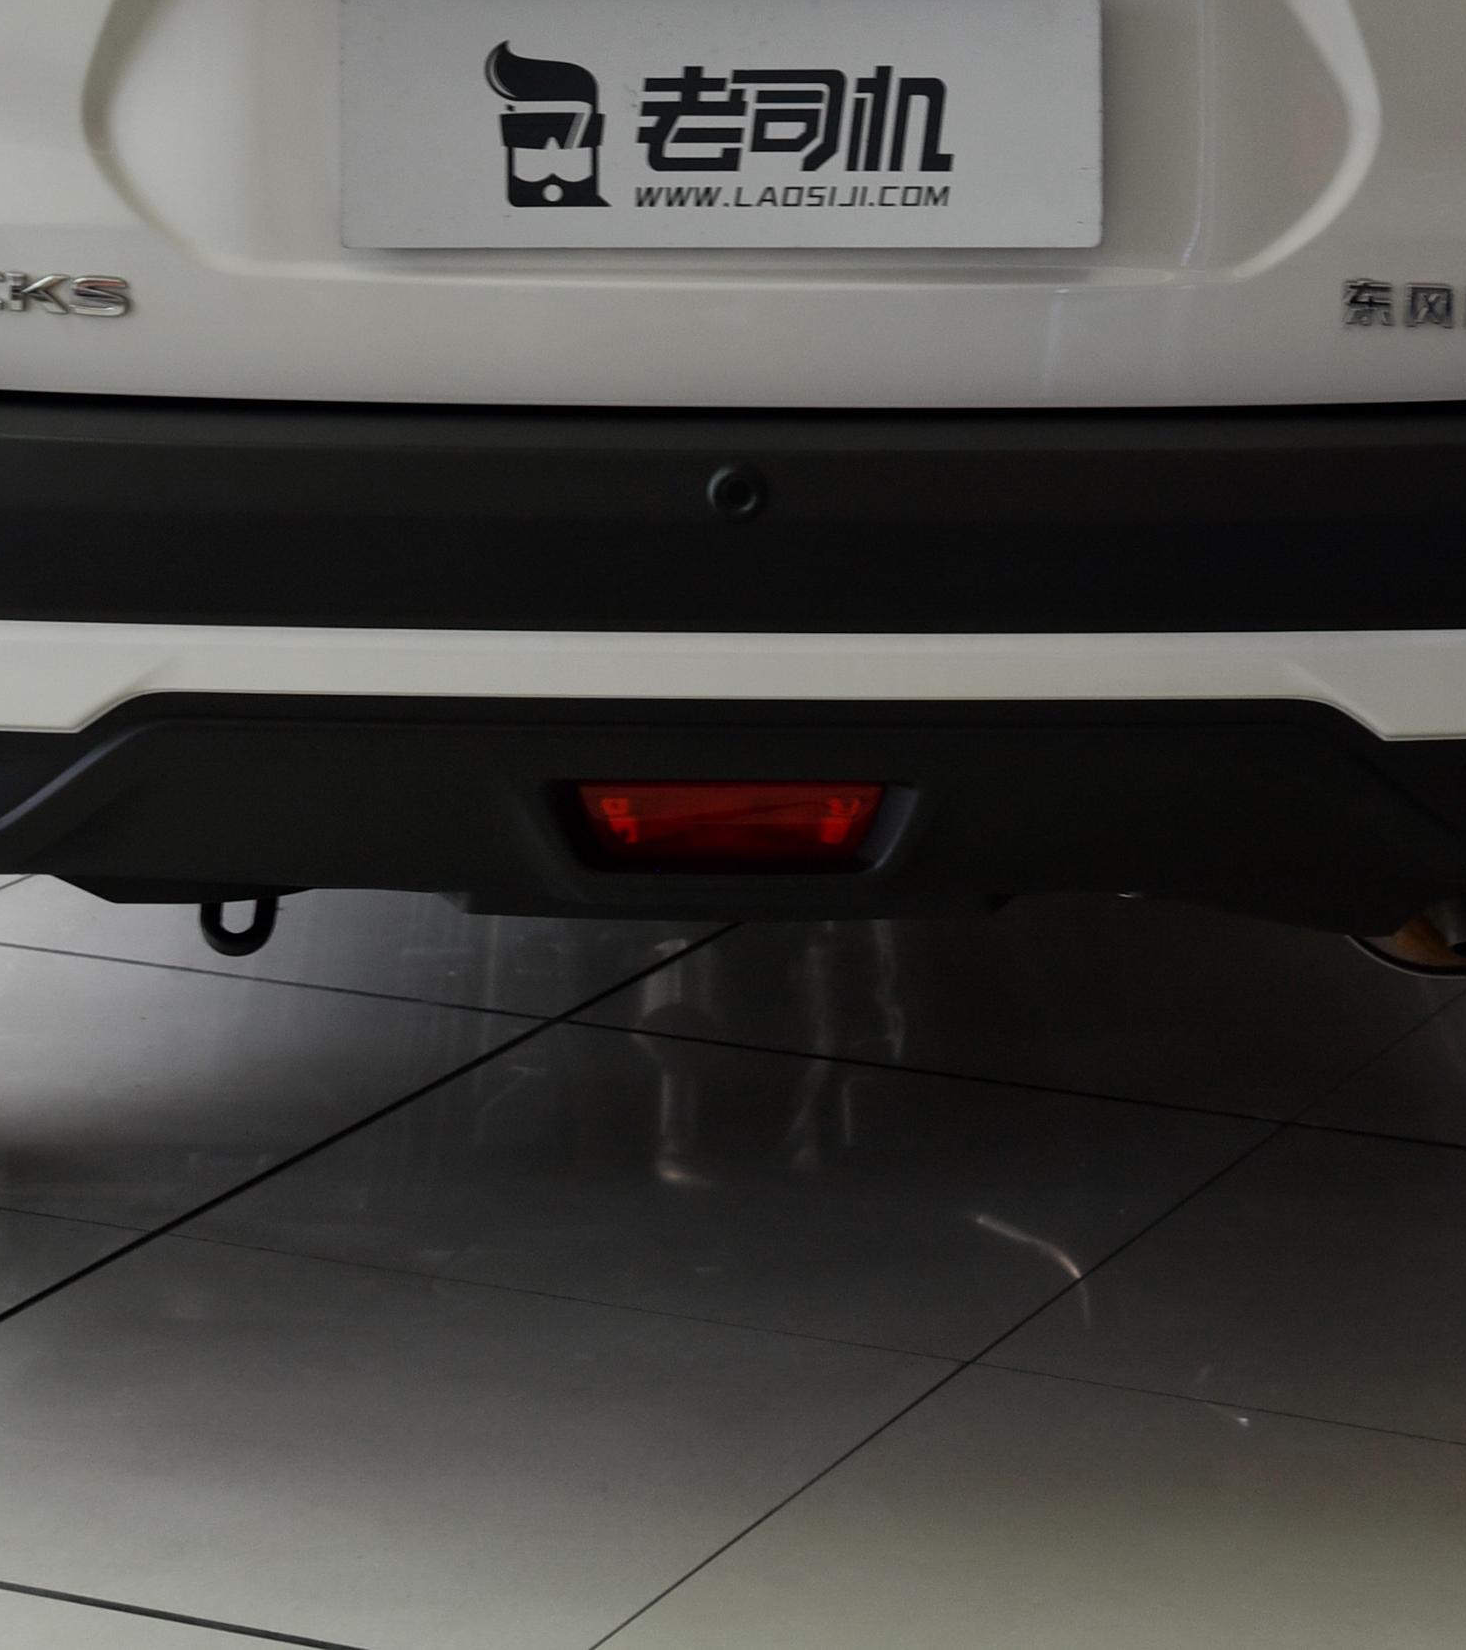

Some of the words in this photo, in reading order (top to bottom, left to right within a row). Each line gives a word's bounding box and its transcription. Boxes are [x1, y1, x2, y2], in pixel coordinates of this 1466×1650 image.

[637, 66, 954, 171] 老司机
[635, 186, 950, 207] WWW.LAOSIJI.COM
